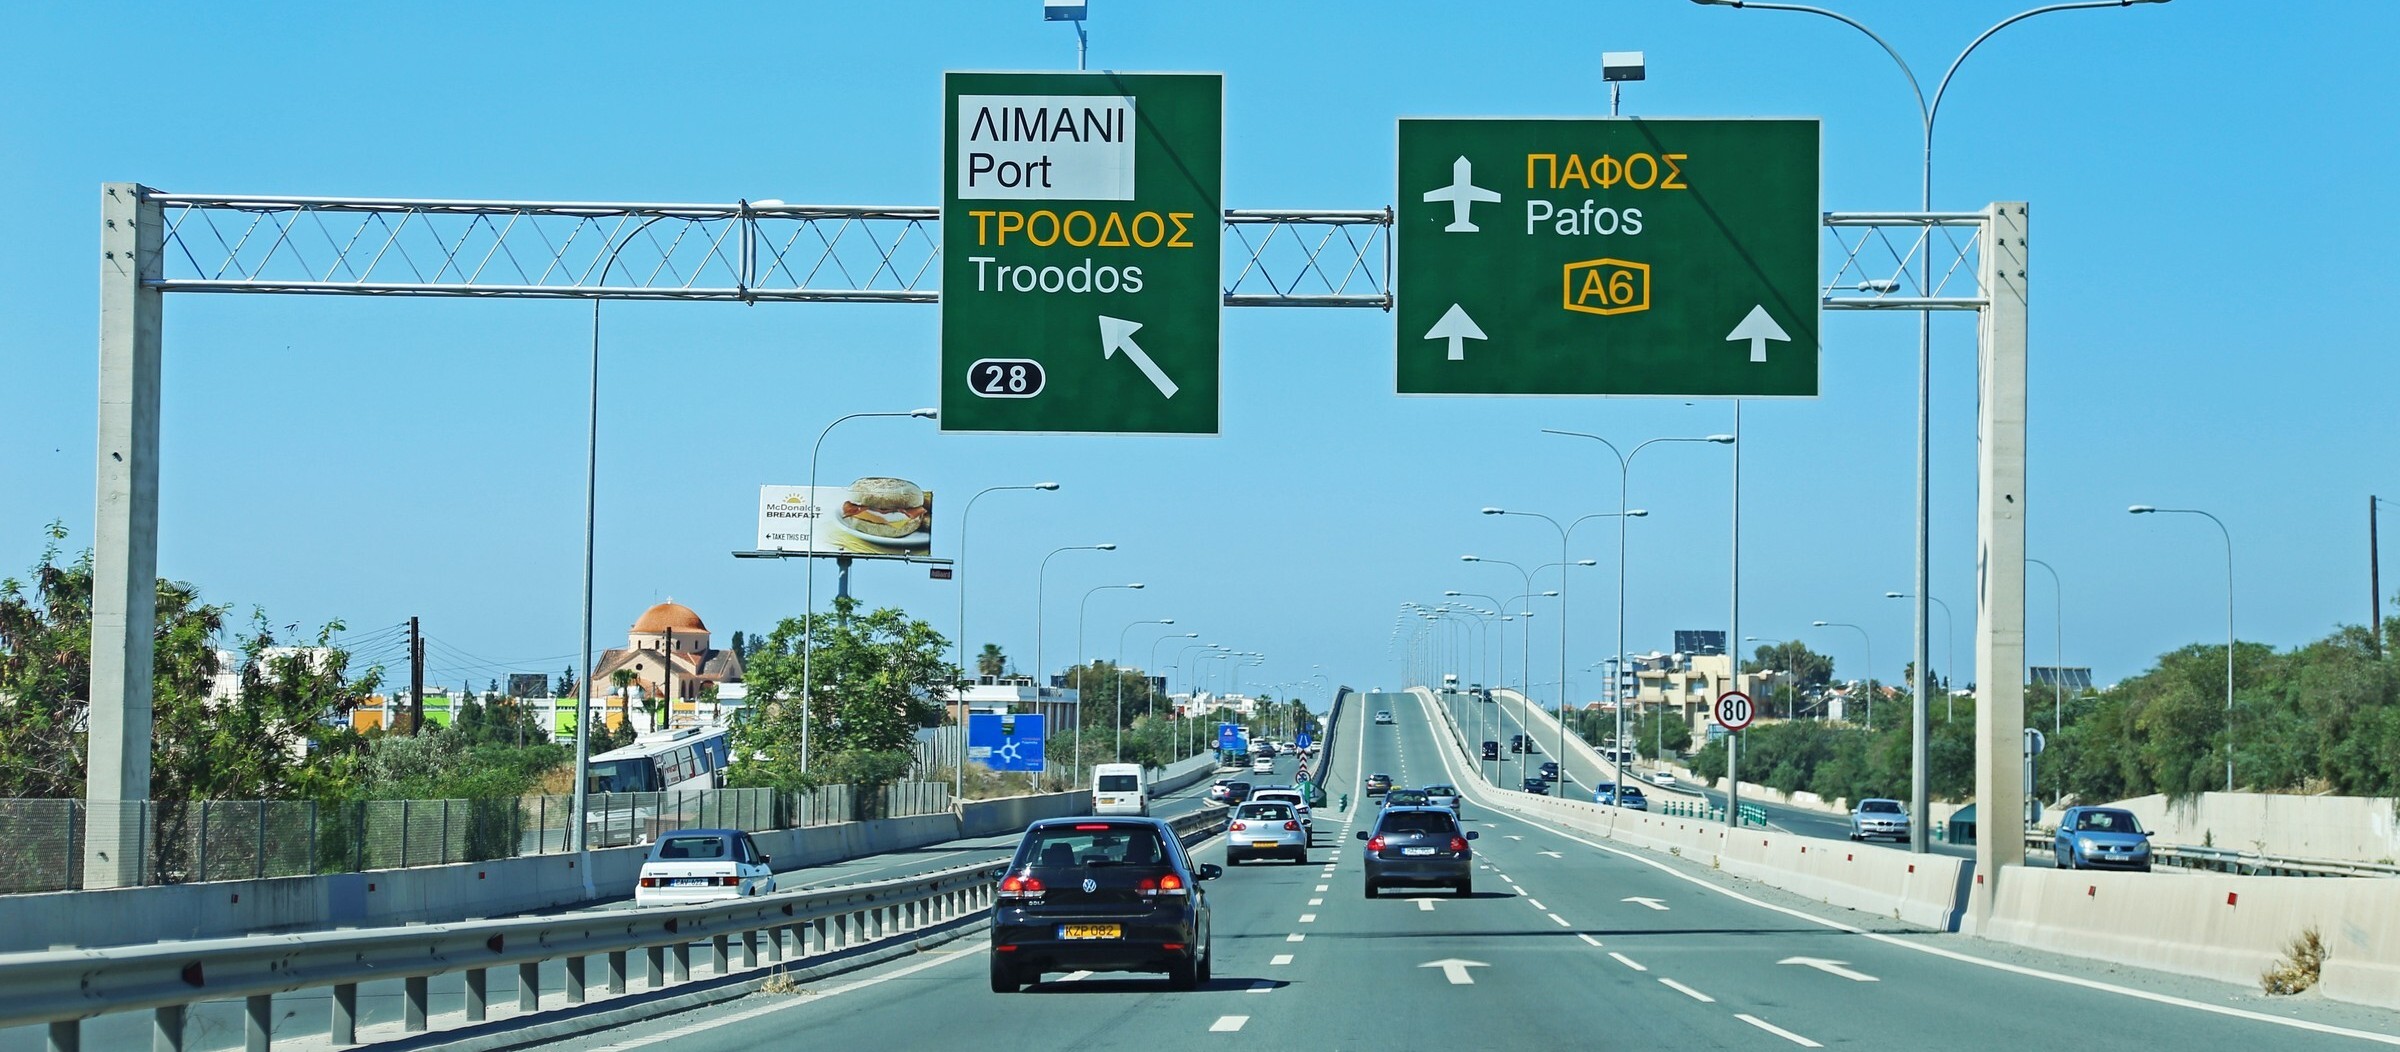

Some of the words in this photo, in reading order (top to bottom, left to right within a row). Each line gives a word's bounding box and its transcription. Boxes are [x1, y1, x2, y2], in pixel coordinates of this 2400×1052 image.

[970, 106, 1124, 143] ΛΙΜΑΝΙ
[969, 153, 1052, 188] Port
[1527, 153, 1688, 190] ΠΑΦΟΣ
[968, 210, 1194, 248] ΤΡΟΟΔΟΣ
[1527, 200, 1643, 236] Pafos
[968, 256, 1144, 293] Troodos
[1577, 269, 1634, 305] A6
[985, 365, 1027, 393] 28
[772, 533, 785, 541] TAKE
[786, 533, 799, 541] THIS
[1723, 700, 1746, 721] 80
[1065, 925, 1088, 936] KZP
[1090, 925, 1114, 936] 082
